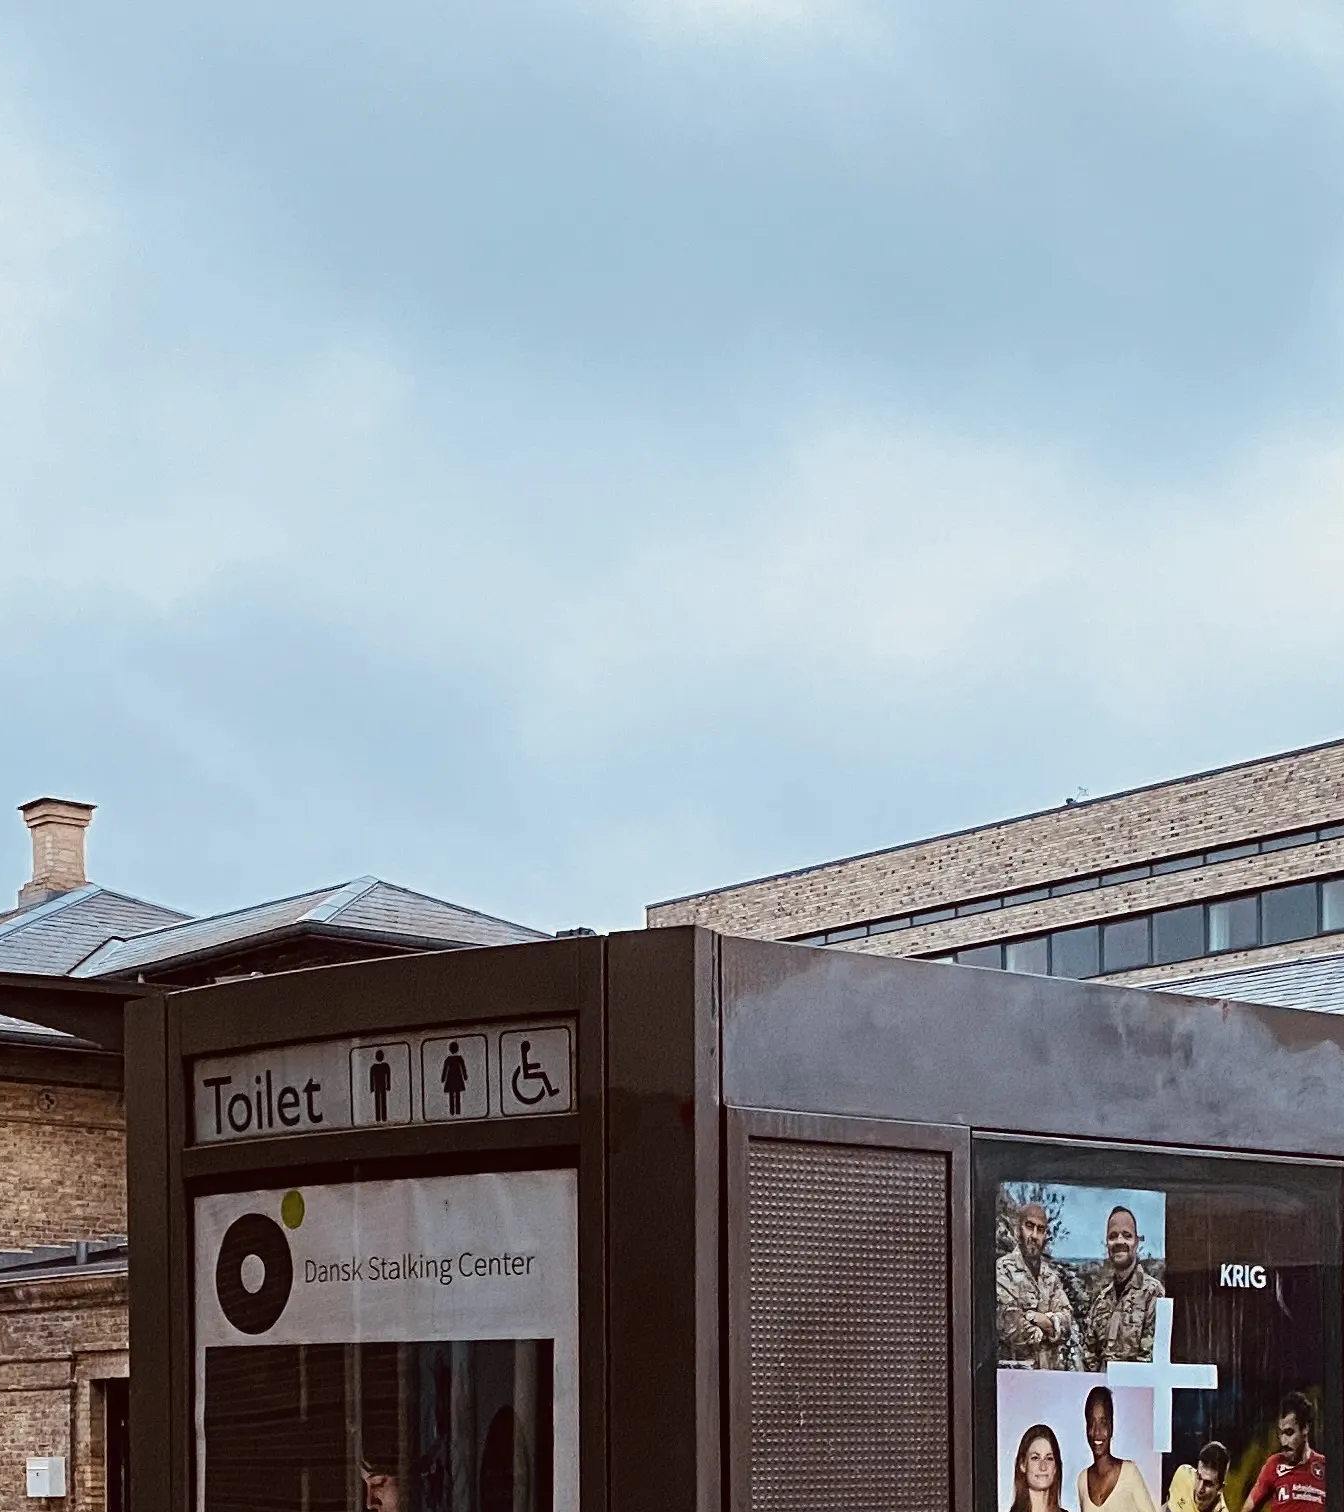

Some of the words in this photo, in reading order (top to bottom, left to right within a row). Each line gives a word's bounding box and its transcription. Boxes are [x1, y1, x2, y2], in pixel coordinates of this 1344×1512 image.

[202, 1069, 324, 1135] Toilet
[305, 1256, 364, 1283] Dansk
[368, 1254, 453, 1286] Stalking
[458, 1252, 536, 1278] Center
[1220, 1263, 1267, 1289] KRIG
